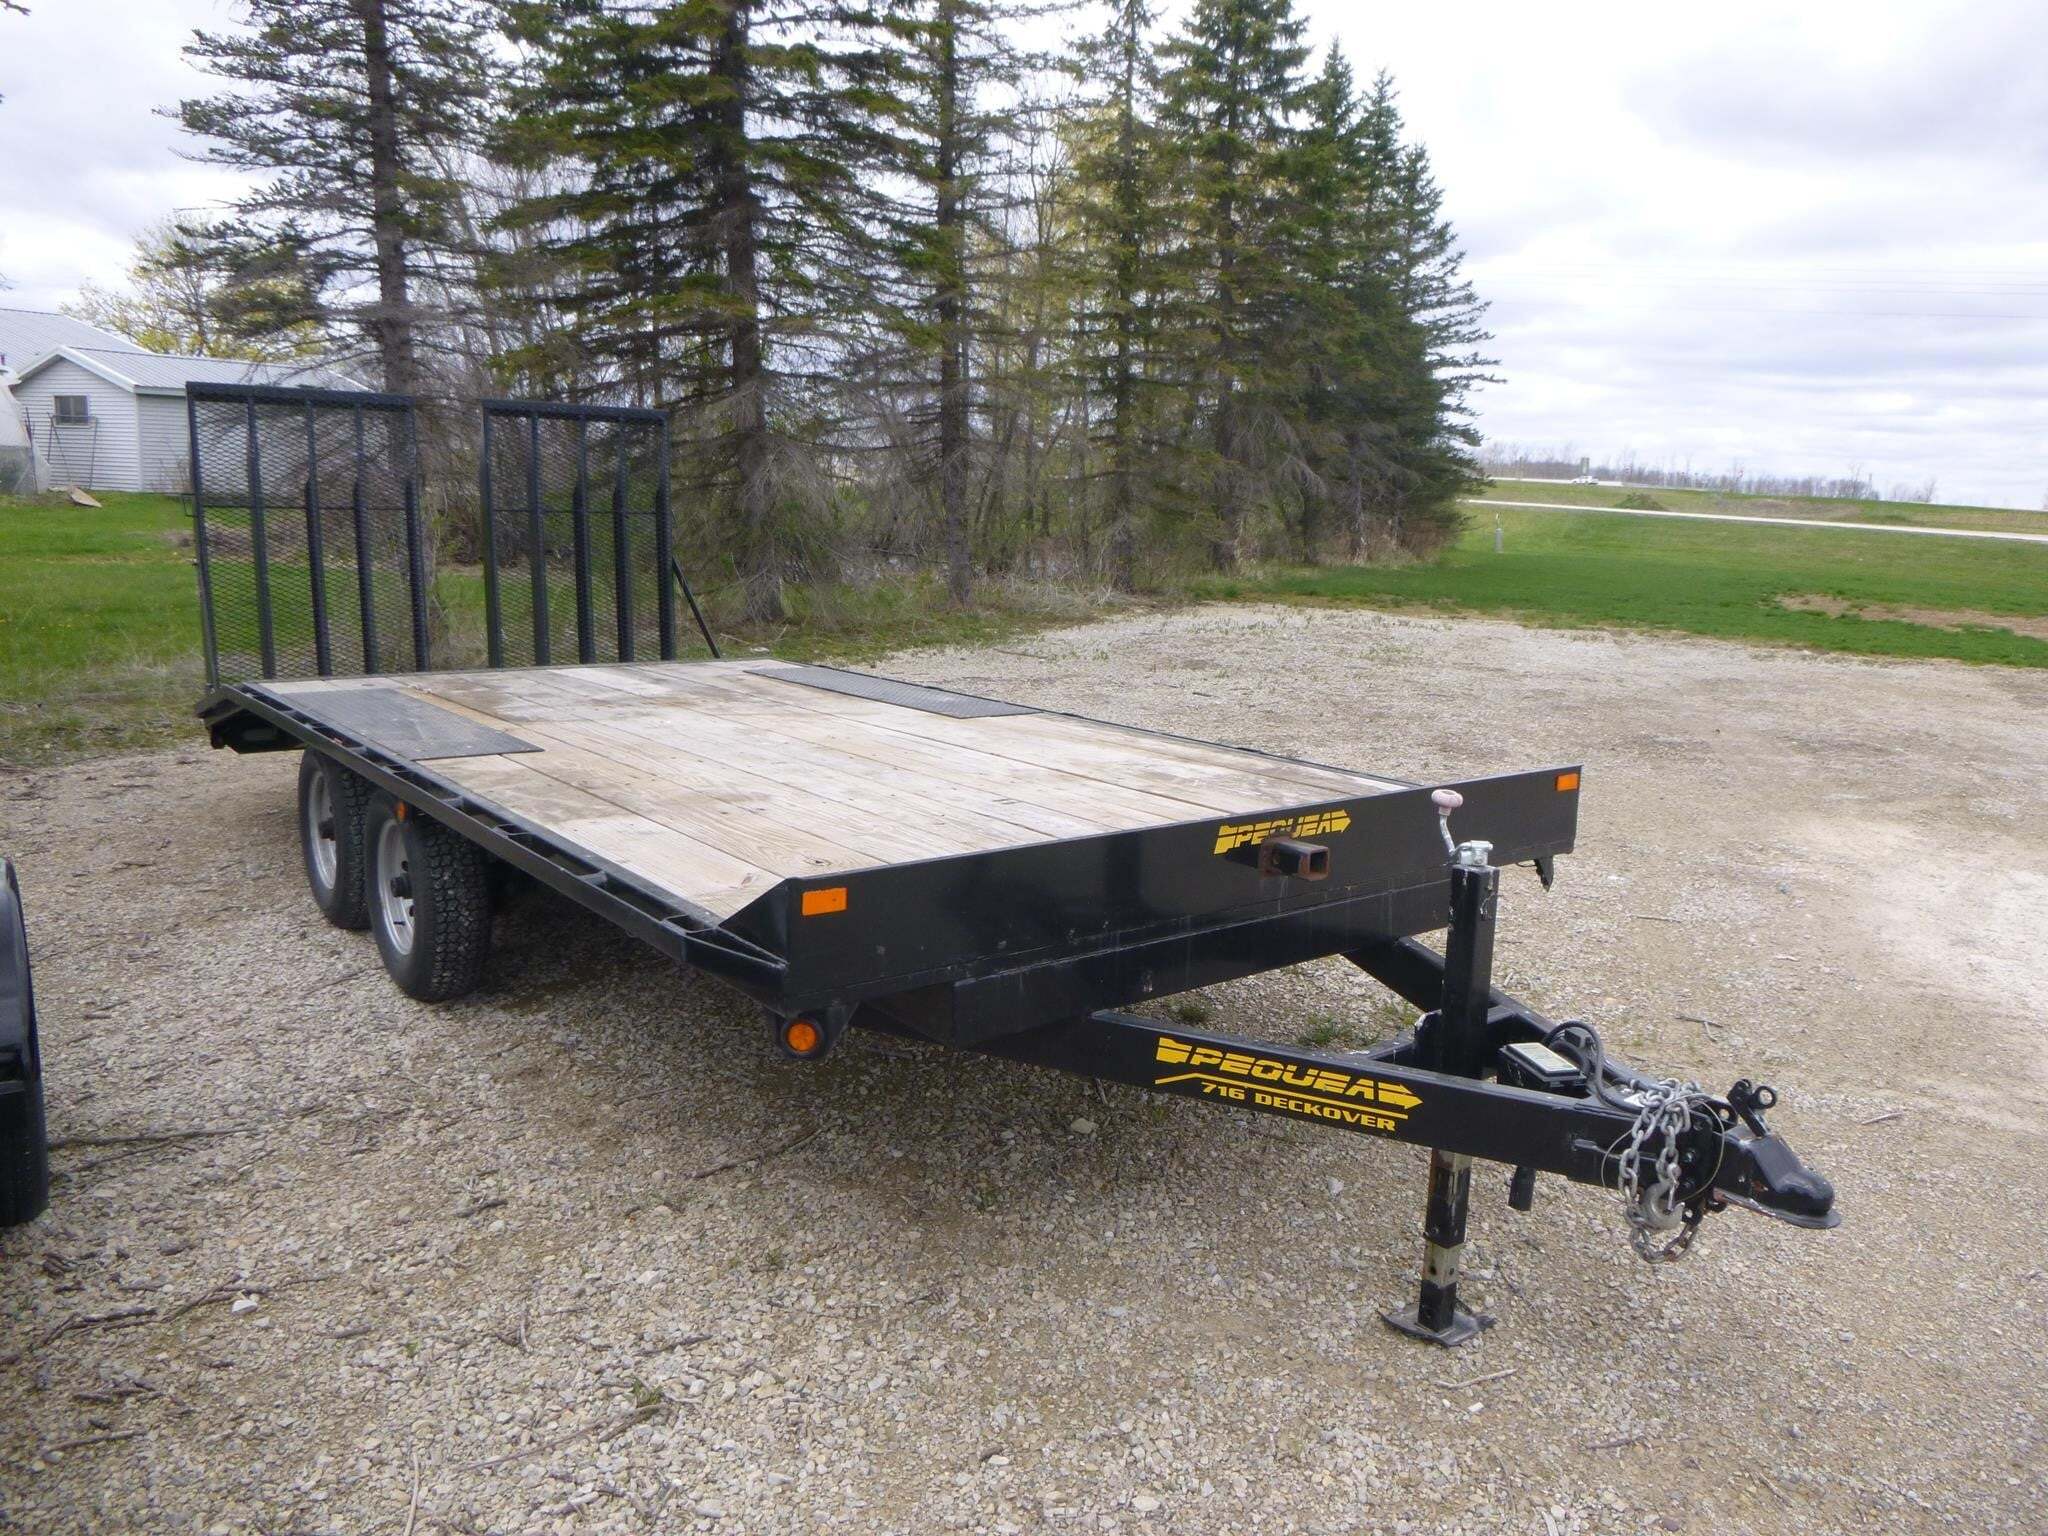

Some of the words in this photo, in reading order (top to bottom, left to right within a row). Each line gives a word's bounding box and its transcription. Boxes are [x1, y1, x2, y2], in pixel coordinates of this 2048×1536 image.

[1189, 1046, 1376, 1101] PEQUEA
[1201, 1081, 1246, 1101] 716
[1253, 1092, 1397, 1132] DECKOVER
